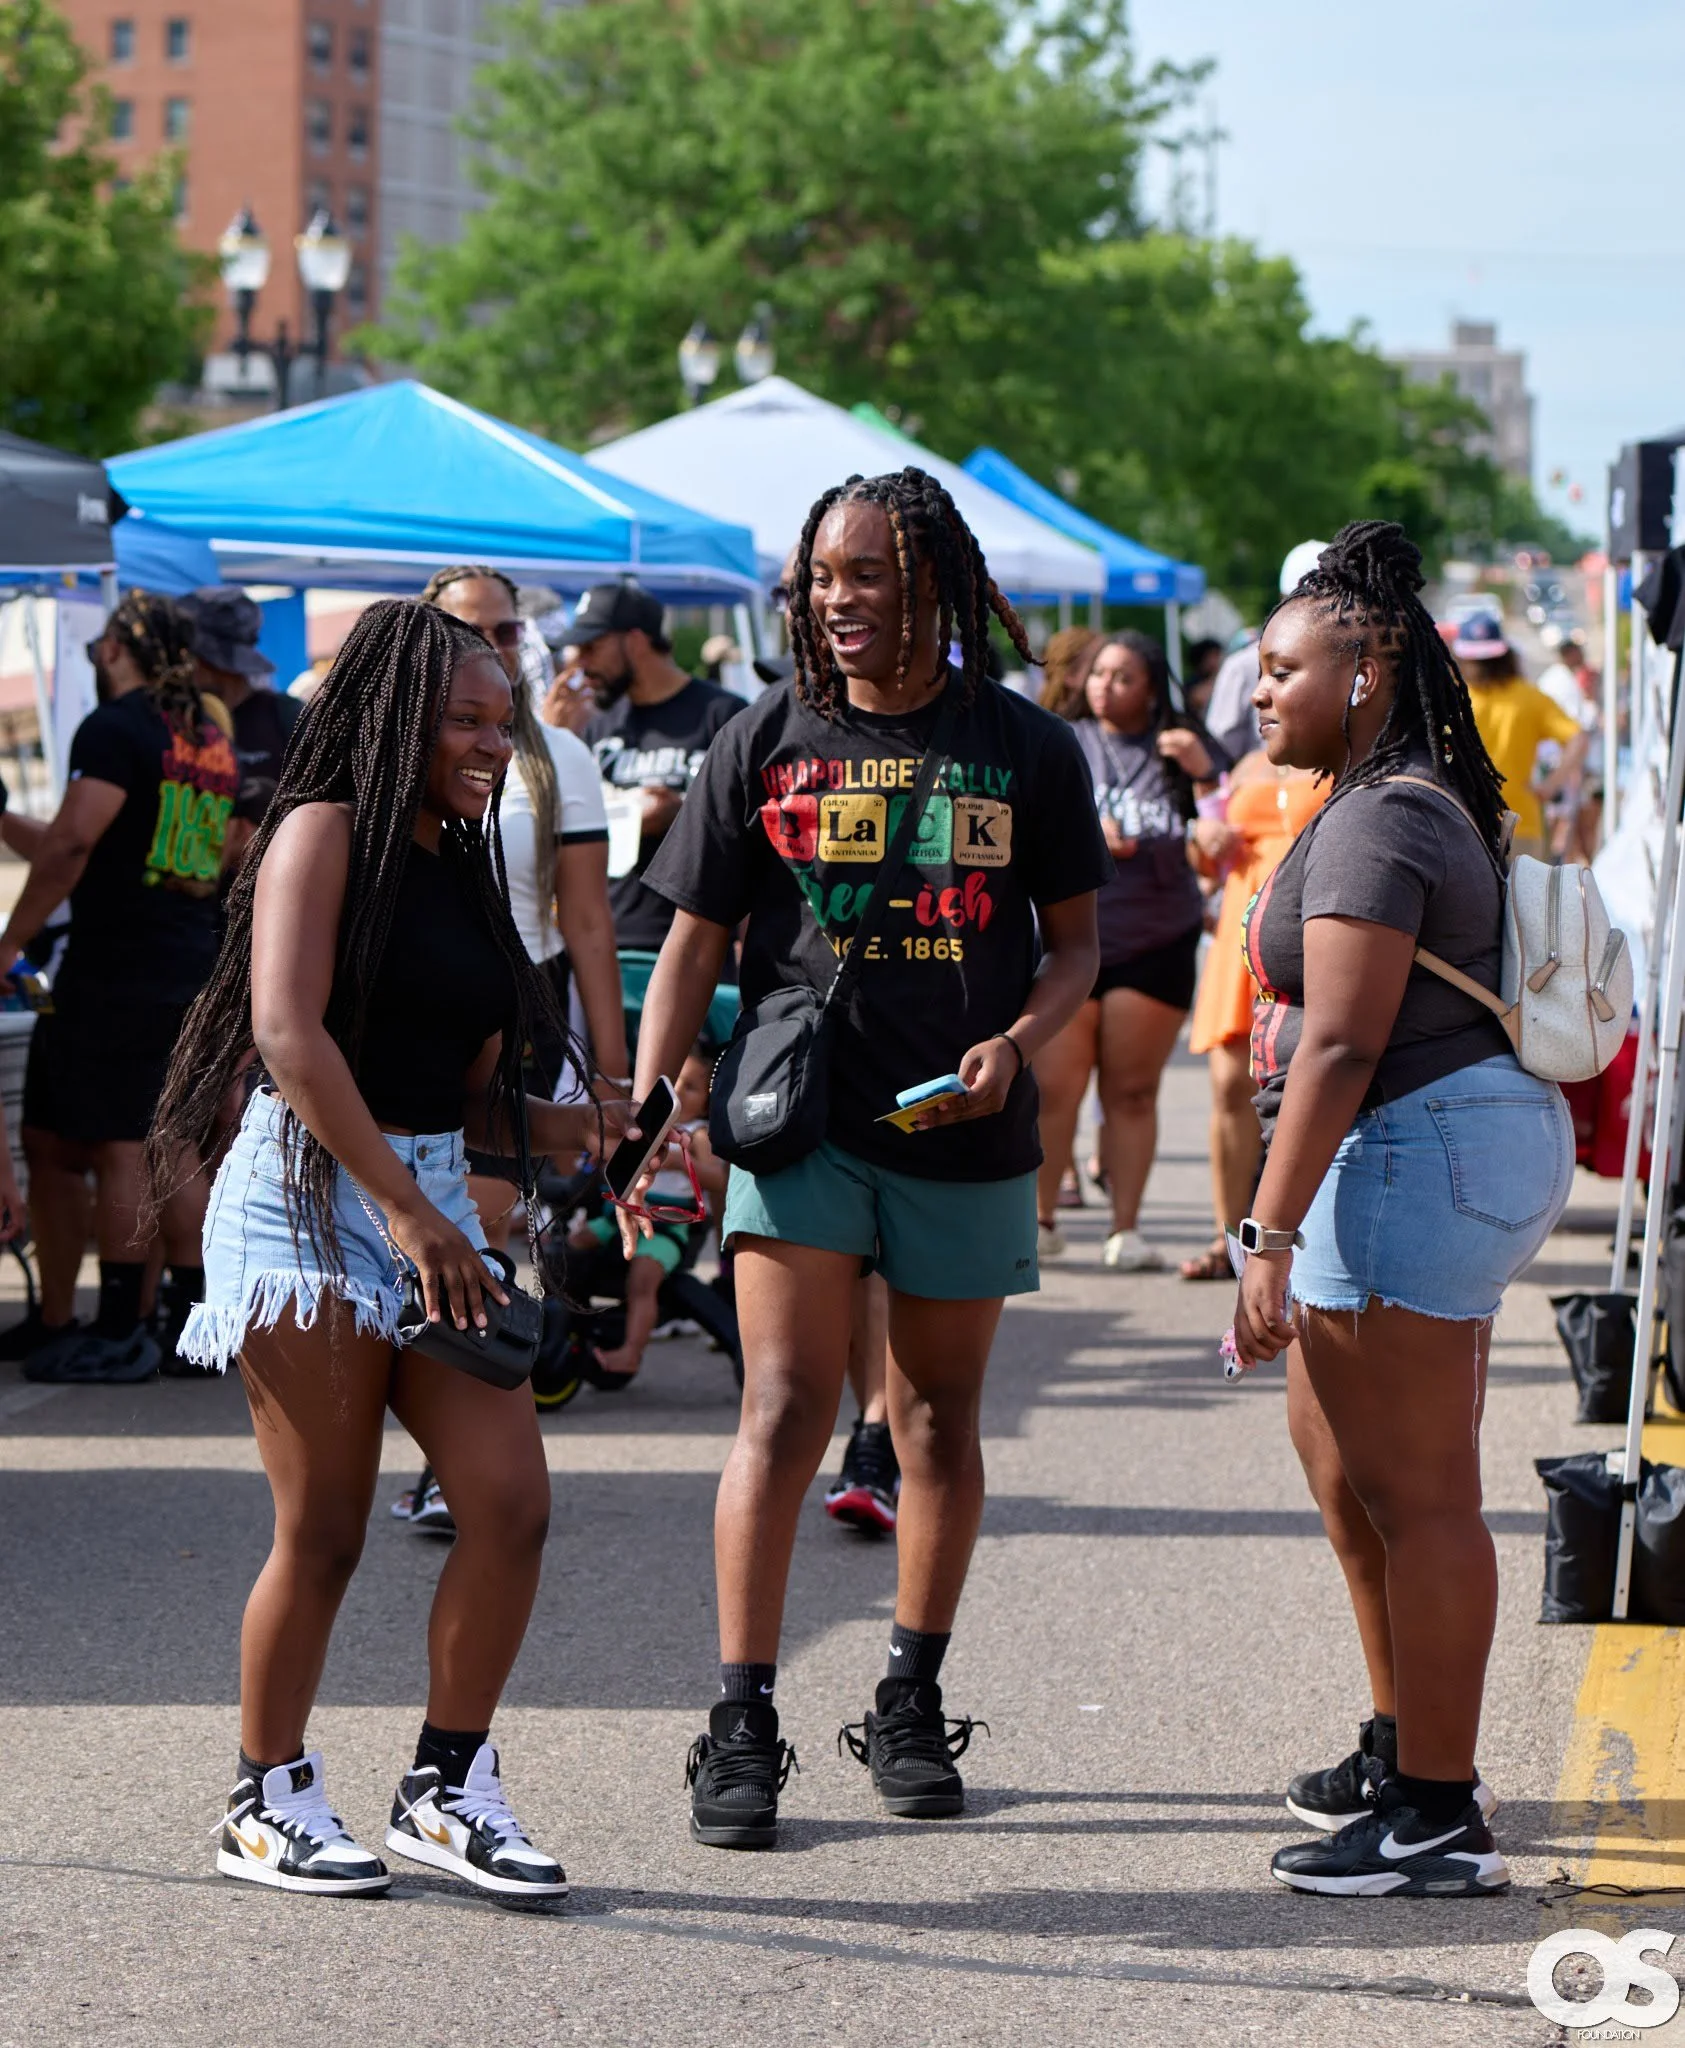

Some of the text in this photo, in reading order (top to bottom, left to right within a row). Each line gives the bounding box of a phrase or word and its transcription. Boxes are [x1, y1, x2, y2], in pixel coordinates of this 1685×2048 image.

[826, 811, 877, 843] La
[966, 814, 998, 847] K
[901, 936, 965, 962] 1865
